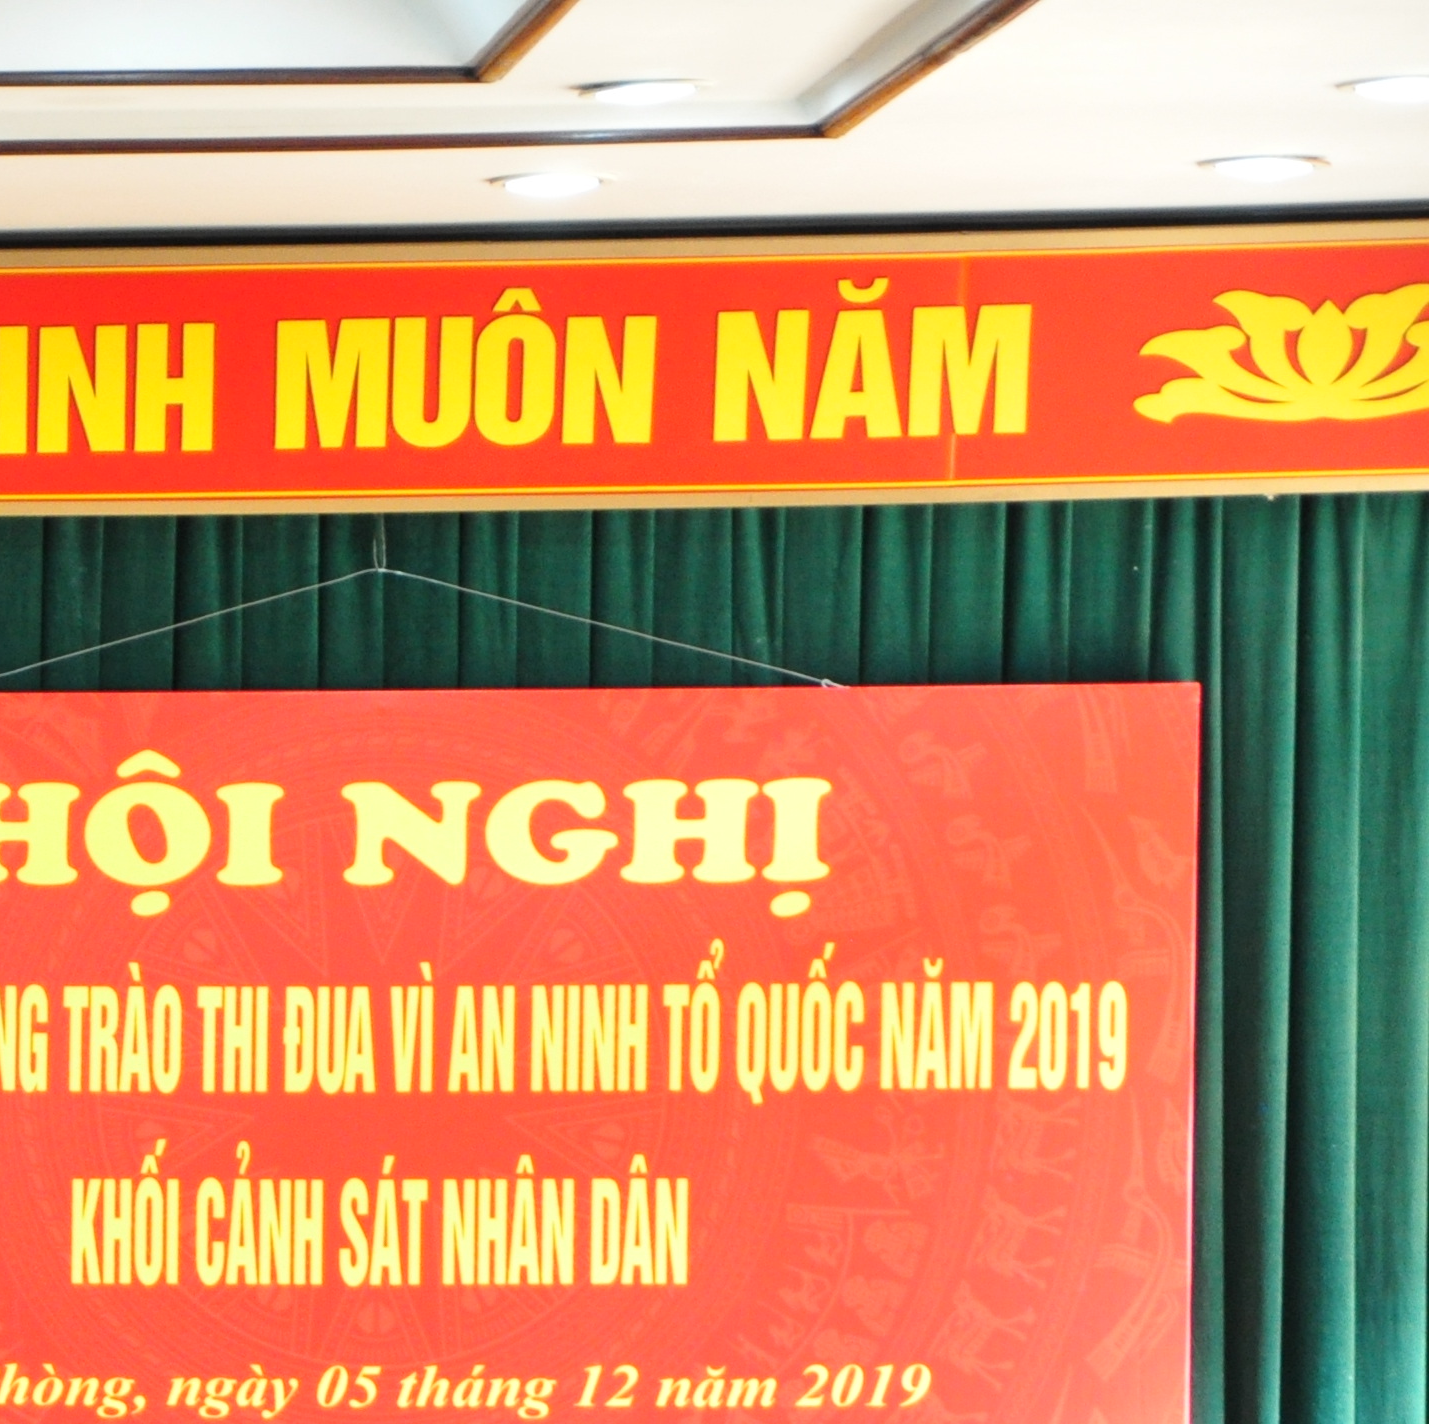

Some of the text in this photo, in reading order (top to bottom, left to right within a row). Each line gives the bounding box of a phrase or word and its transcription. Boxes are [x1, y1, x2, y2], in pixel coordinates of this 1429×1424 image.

[274, 288, 659, 452] MUÔN
[713, 277, 1031, 445] NĂM
[341, 777, 832, 918] NGHỊ
[63, 962, 182, 1094] TRÀO
[197, 986, 269, 1093] THI
[283, 986, 376, 1095] ĐUA
[390, 962, 434, 1093] VÌ
[448, 985, 516, 1093] AN
[530, 984, 649, 1092] NINH
[663, 938, 724, 1093] TỔ
[736, 942, 865, 1105] QUỐC
[879, 958, 994, 1091] NĂM
[1007, 980, 1129, 1092] 2019
[71, 1139, 689, 1288] KHỐI CẢNH SÁT NHÂN DÂN
[166, 1364, 299, 1421] ngày
[317, 1365, 382, 1409] 05
[397, 1364, 557, 1421] tháng
[574, 1364, 639, 1408] 12
[655, 1366, 777, 1410] năm
[794, 1363, 932, 1409] 2019
